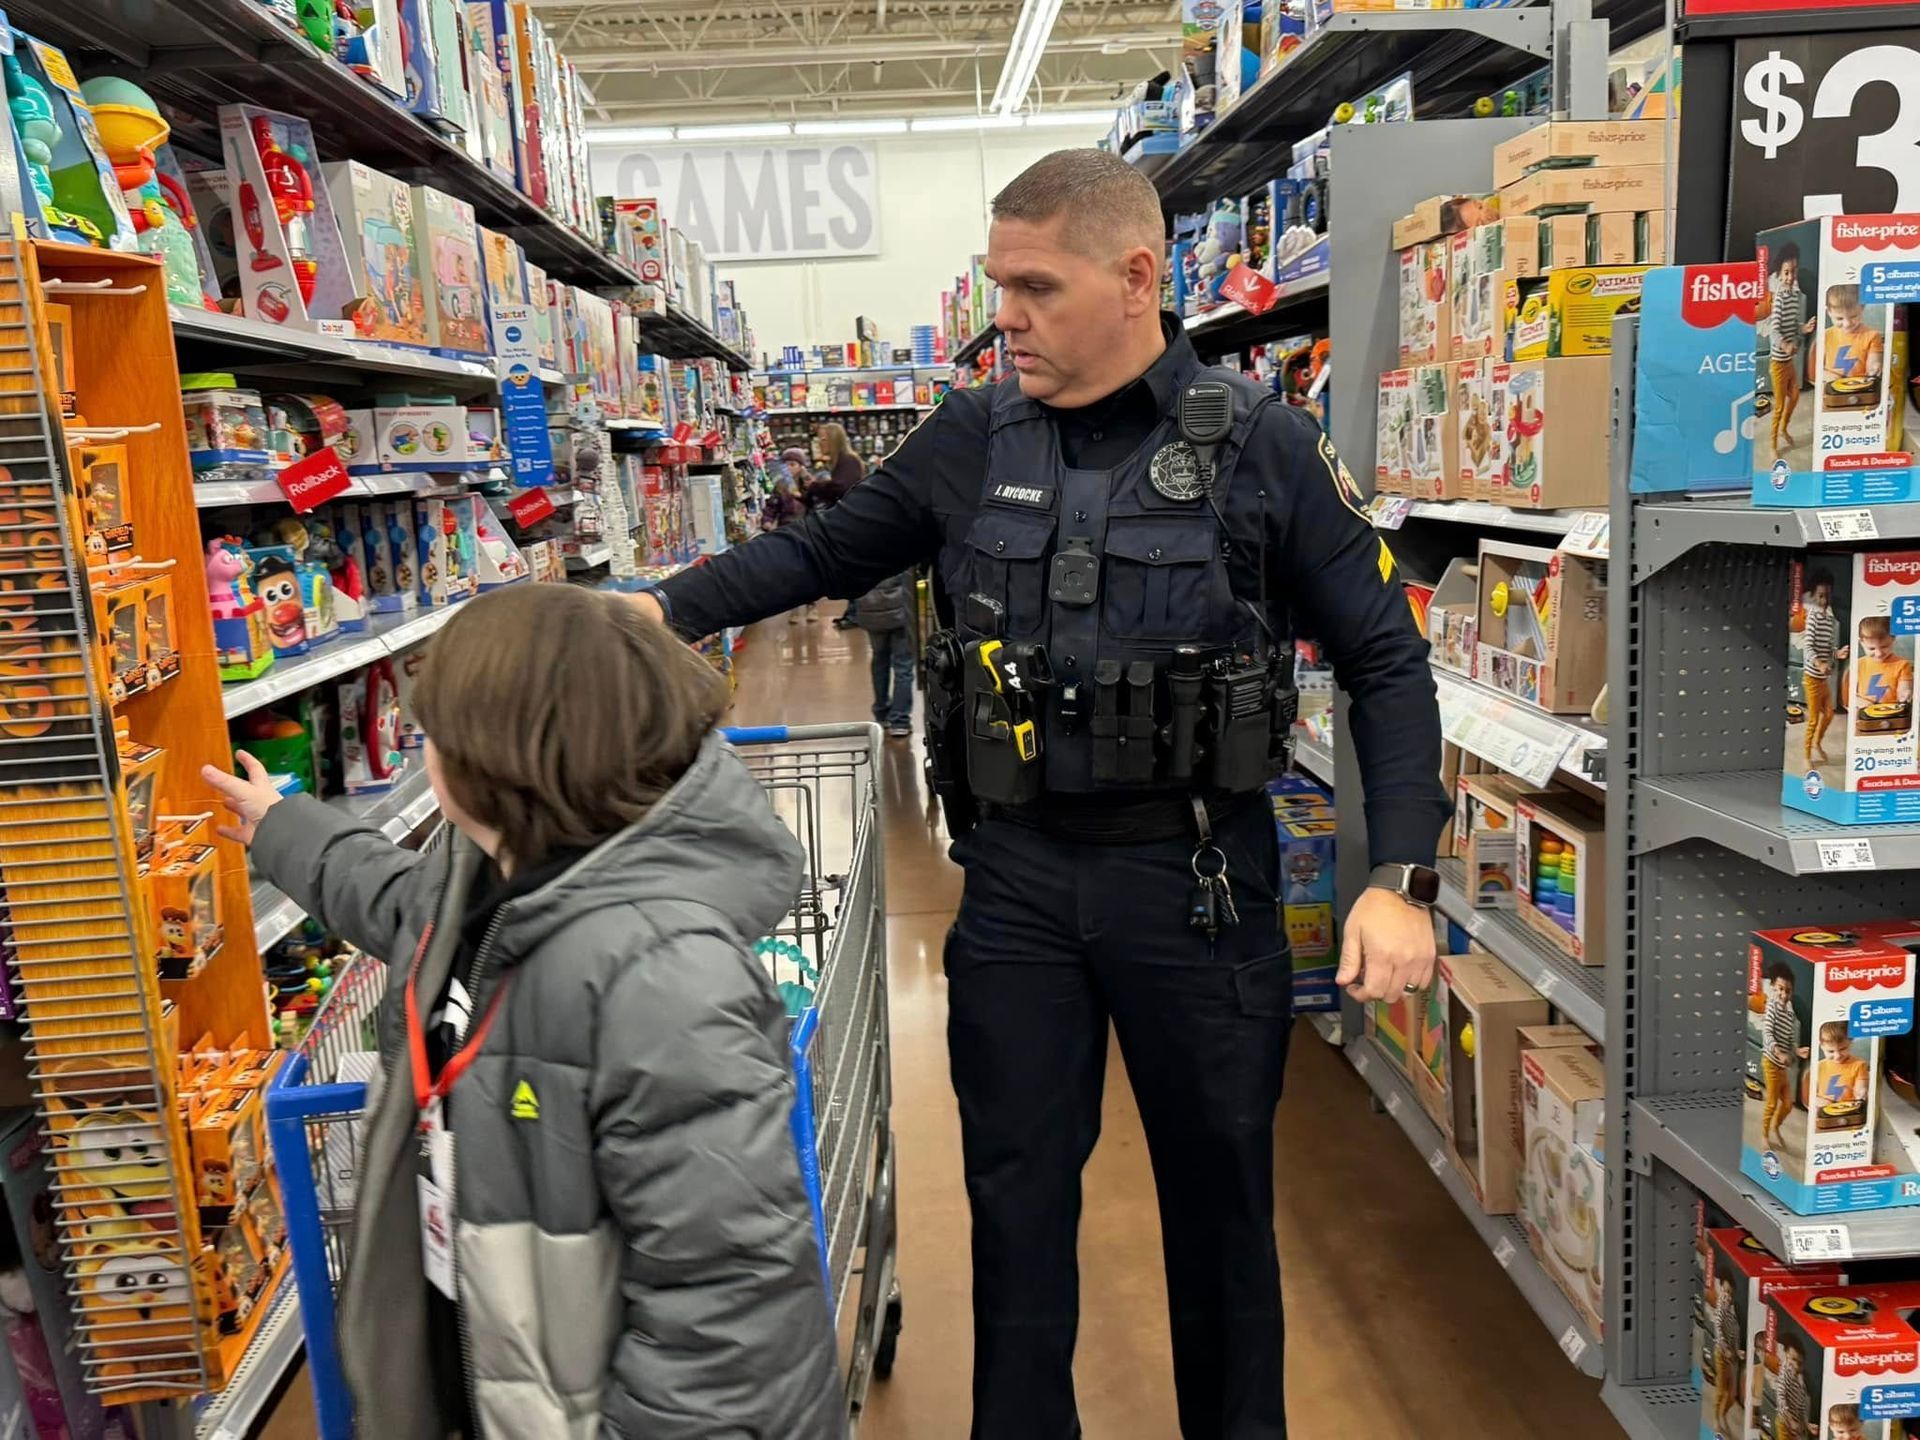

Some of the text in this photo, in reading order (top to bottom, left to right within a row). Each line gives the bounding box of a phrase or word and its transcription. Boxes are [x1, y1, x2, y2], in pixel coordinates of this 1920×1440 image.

[1836, 222, 1919, 240] fisher-price
[1873, 267, 1886, 283] 5
[1821, 434, 1880, 449] 20 songs!
[288, 464, 342, 497] Rollback
[1902, 599, 1916, 616] 5
[1854, 756, 1876, 771] 20
[1828, 964, 1903, 981] fisher-price
[1860, 1004, 1872, 1019] 5
[1814, 1151, 1834, 1166] 20
[1838, 1349, 1915, 1367] fisher-price
[1871, 1388, 1883, 1402] 5
